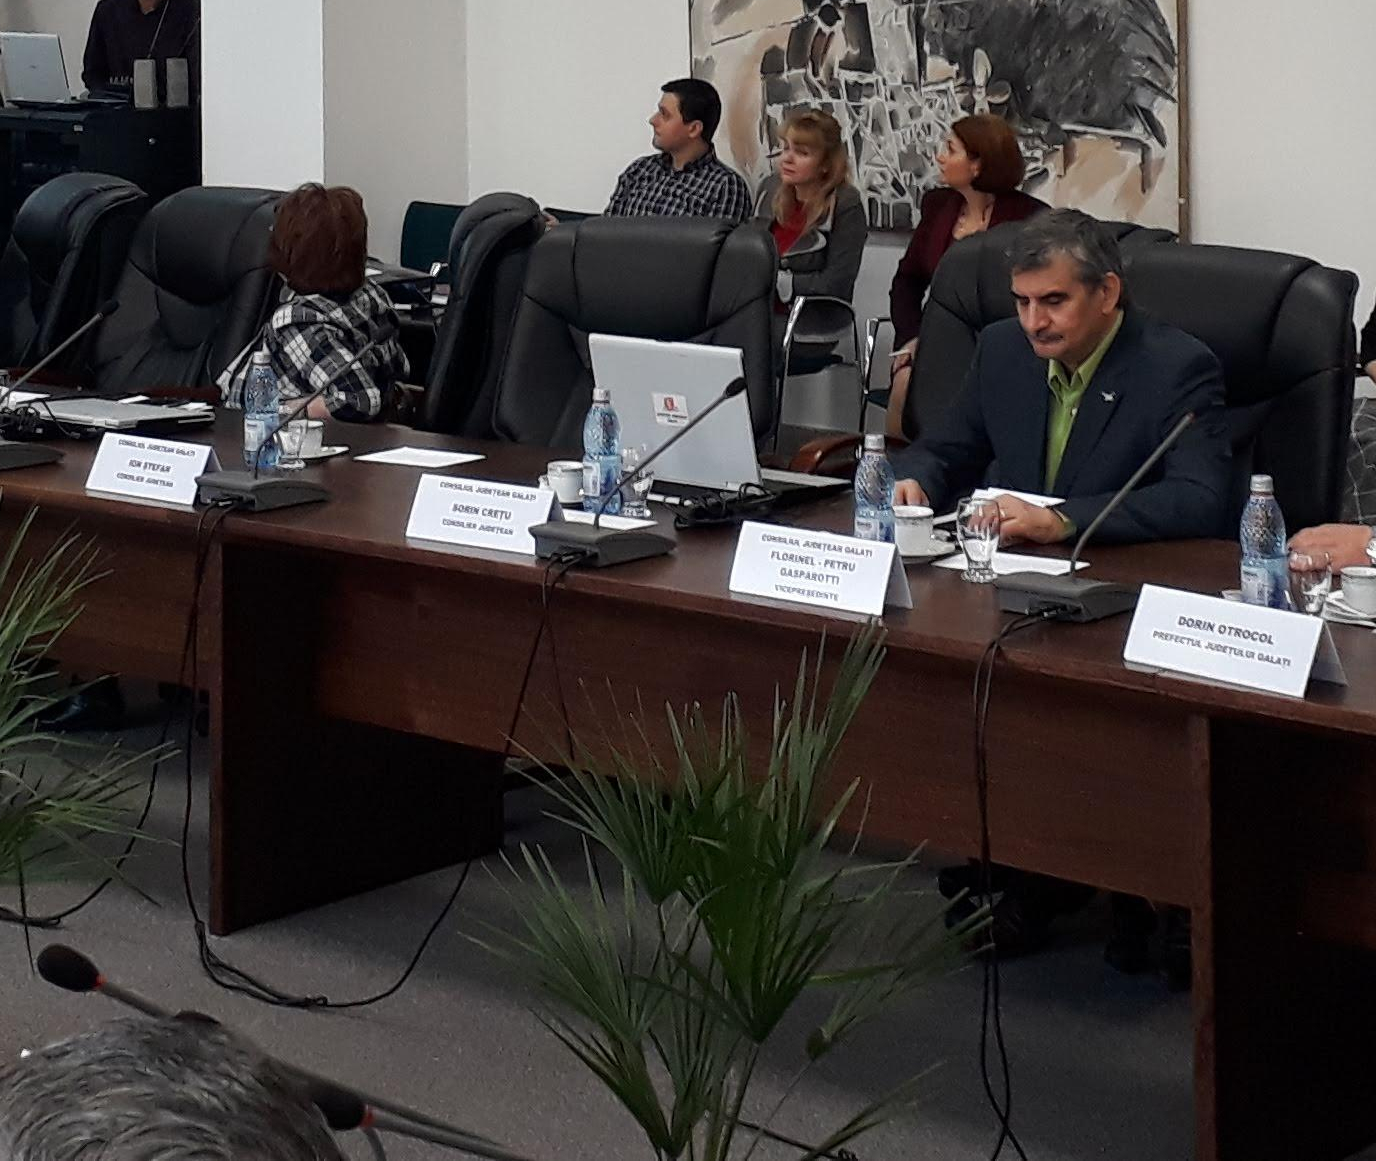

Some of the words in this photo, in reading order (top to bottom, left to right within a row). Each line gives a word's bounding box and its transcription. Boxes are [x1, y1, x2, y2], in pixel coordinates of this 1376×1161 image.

[452, 503, 479, 515] SORIN
[481, 507, 512, 520] CREȚU
[770, 550, 816, 567] FLORINEL
[823, 559, 856, 572] PETRU
[780, 567, 840, 586] GASPAROTTI
[1152, 630, 1202, 648] PREFECTUL
[1178, 616, 1215, 632] DORIN
[1217, 623, 1275, 645] OTROCOL
